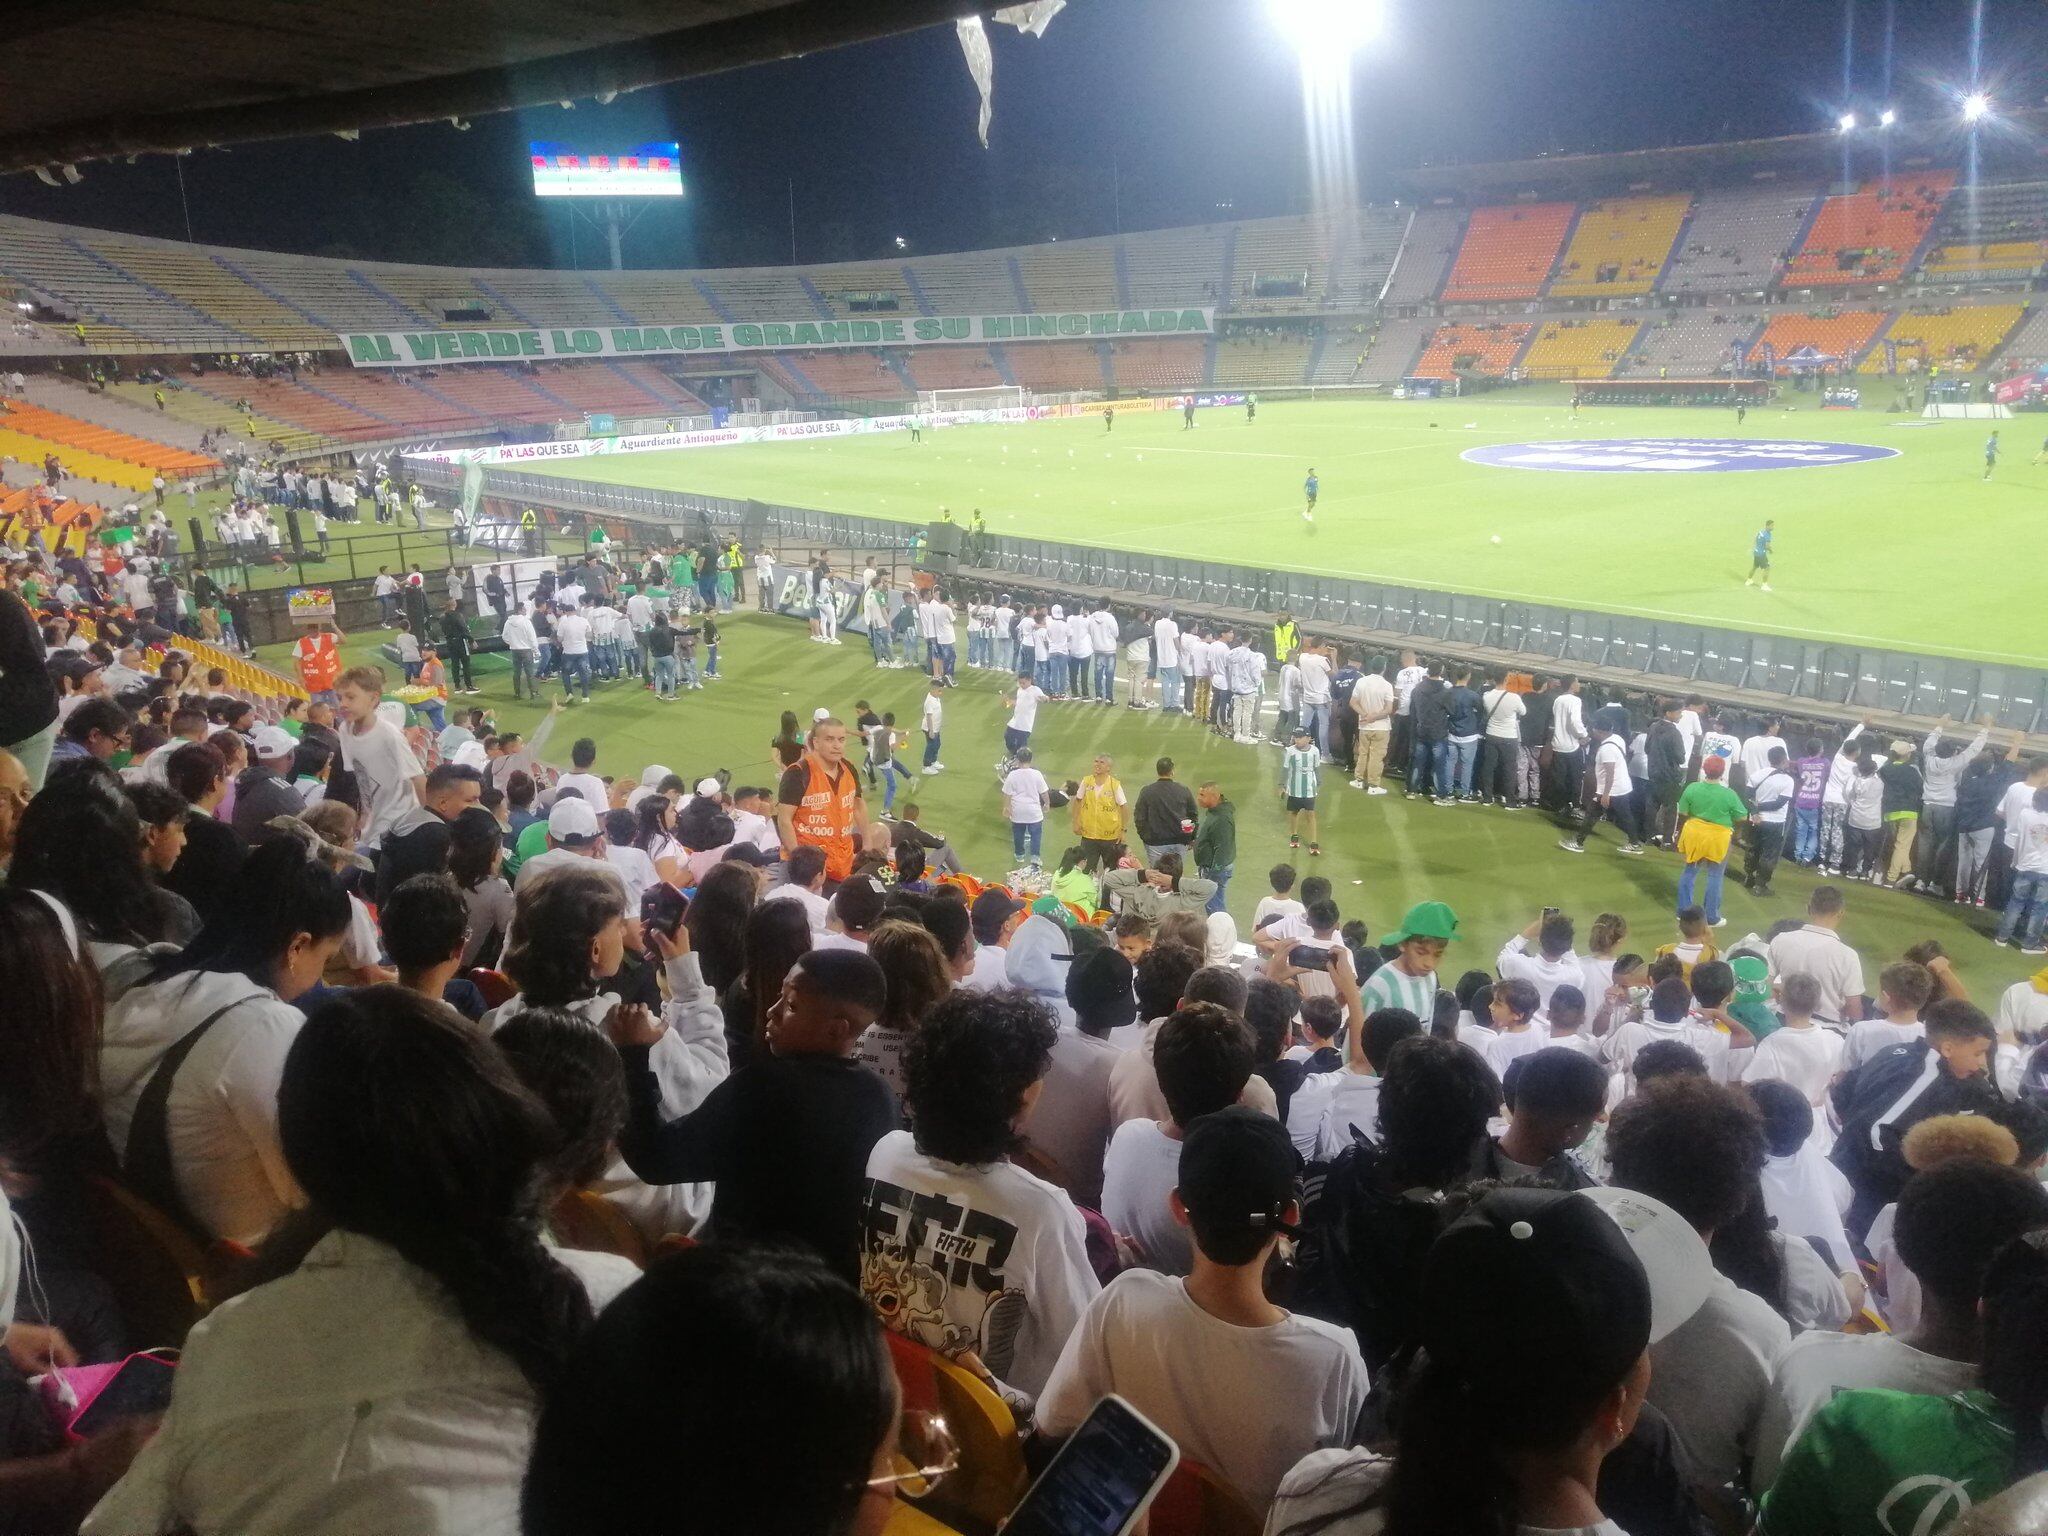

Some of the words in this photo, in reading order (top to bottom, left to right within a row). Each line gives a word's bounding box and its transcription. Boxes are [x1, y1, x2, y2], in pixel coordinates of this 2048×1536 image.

[349, 335, 402, 362] AL
[403, 332, 545, 360] VERDE
[550, 329, 604, 353] LO
[610, 326, 726, 351] HACE
[731, 319, 906, 346] GRANDE
[913, 317, 971, 340] SU
[981, 309, 1209, 338] HINCHADA
[790, 425, 805, 435] LAS
[805, 424, 824, 434] QUE
[825, 423, 841, 433] SEA
[620, 436, 681, 450] Aguardiente
[683, 430, 738, 444] Antioqueño
[516, 447, 535, 458] LAS
[537, 445, 560, 456] QUE
[561, 443, 580, 455] SEA
[1801, 770, 1821, 791] 25
[809, 814, 827, 824] 076
[935, 1231, 977, 1259] FIFTH
